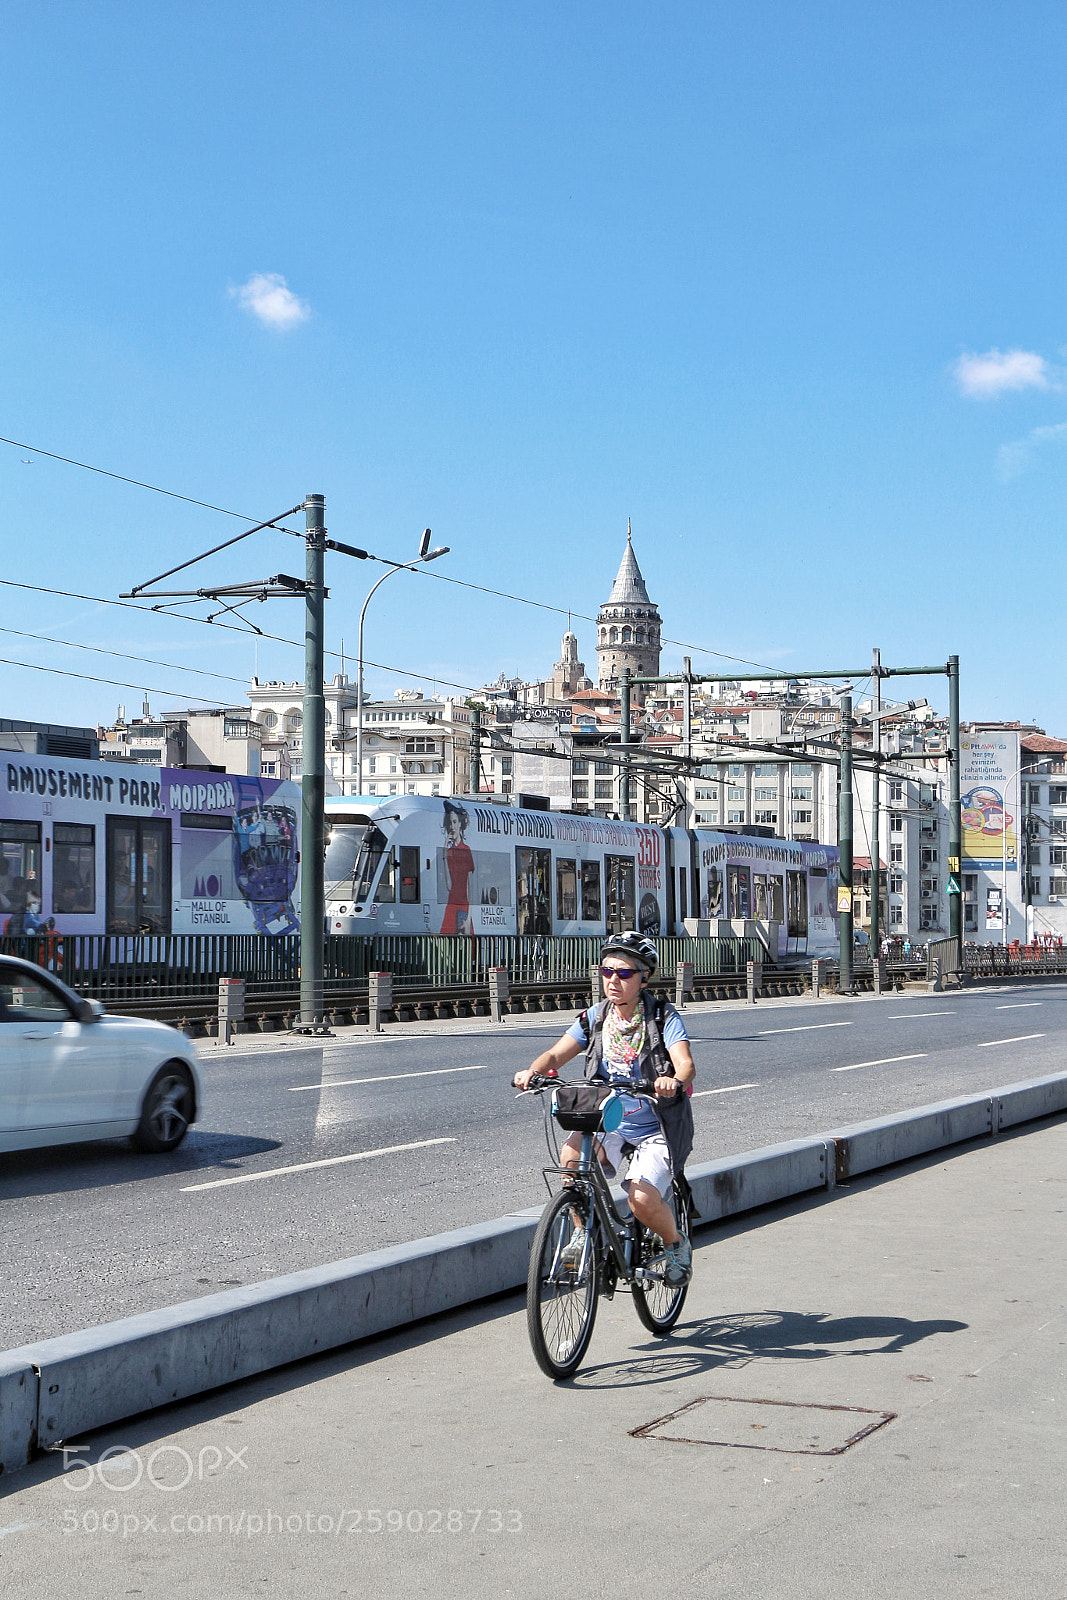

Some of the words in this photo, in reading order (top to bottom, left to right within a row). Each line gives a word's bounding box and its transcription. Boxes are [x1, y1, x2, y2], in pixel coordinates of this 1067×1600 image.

[7, 763, 115, 803] AMUSEMENT
[474, 808, 501, 834] MALL
[501, 811, 516, 836] OF
[636, 827, 660, 868] 350
[638, 869, 661, 890] STORES
[191, 901, 214, 911] MALL
[214, 901, 227, 911] OF
[480, 907, 495, 916] MALL
[495, 907, 504, 916] OF
